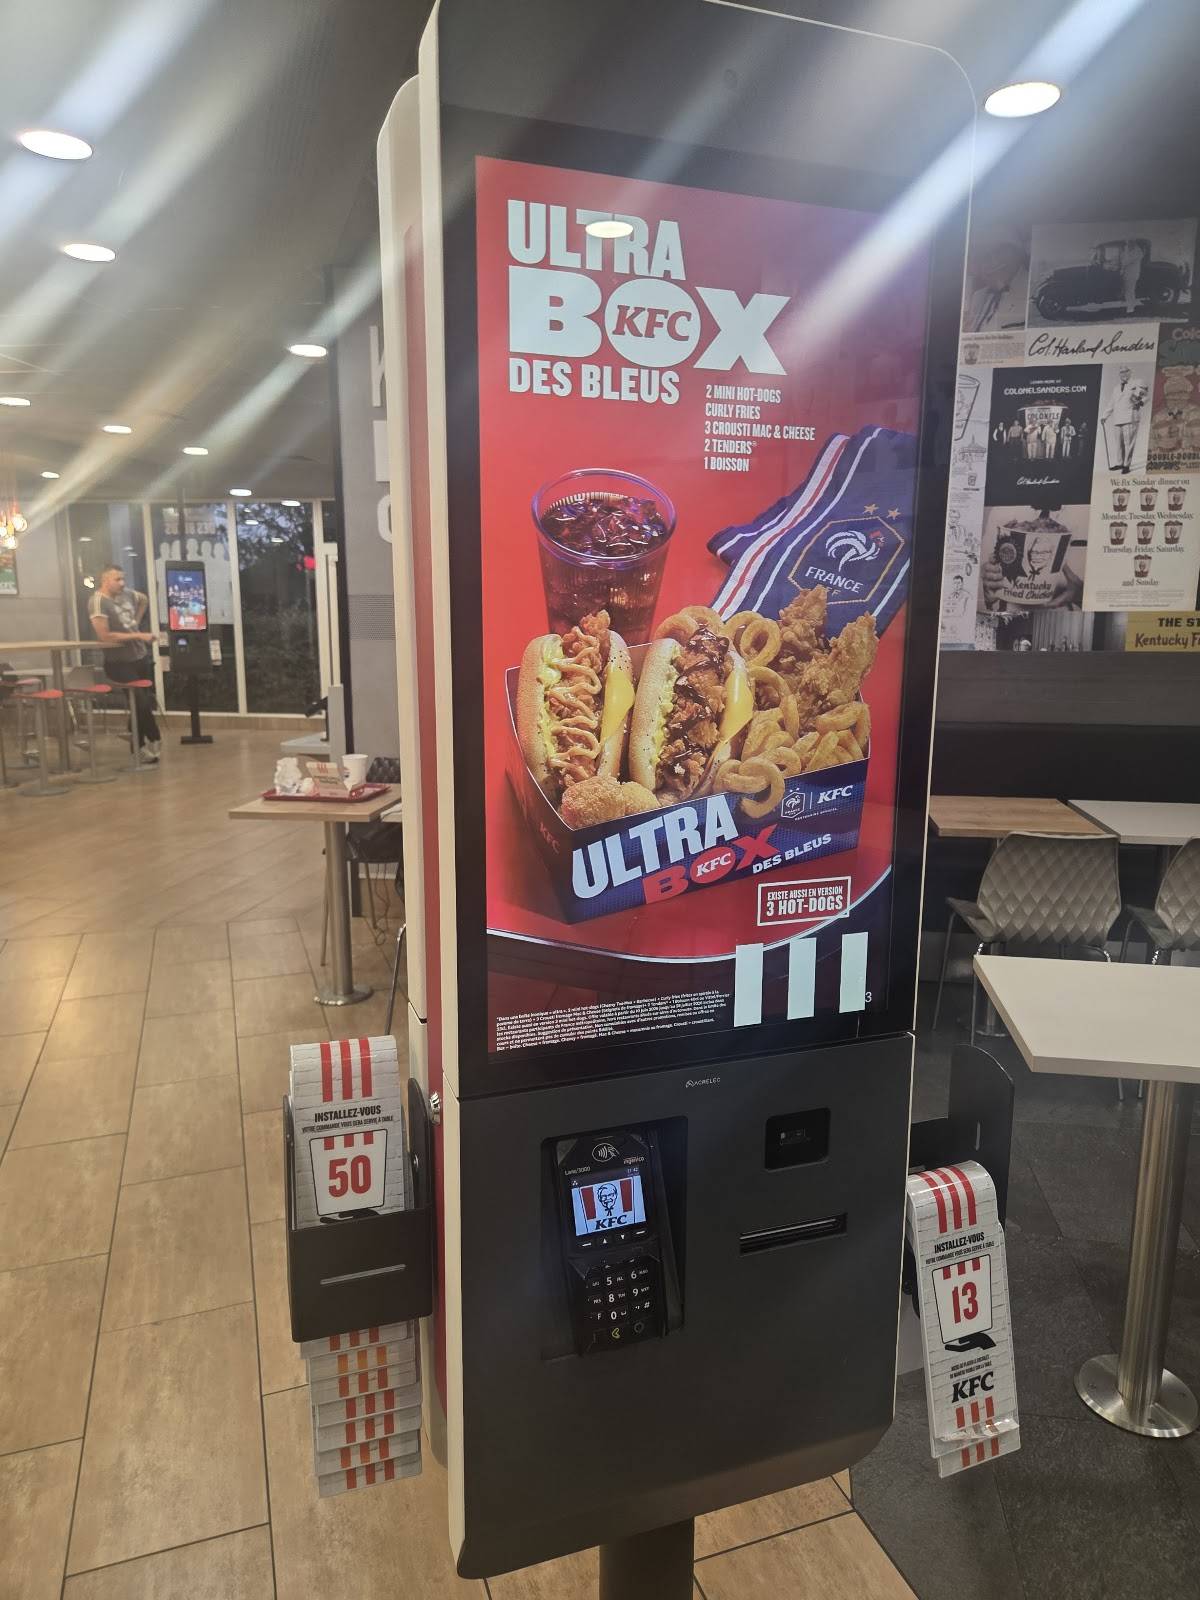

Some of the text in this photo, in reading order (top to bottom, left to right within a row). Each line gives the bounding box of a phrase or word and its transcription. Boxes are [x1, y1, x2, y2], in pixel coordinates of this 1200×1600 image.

[508, 199, 686, 281] ULTRA
[612, 304, 692, 341] KFC
[509, 357, 680, 405] DES BLEUS
[706, 384, 781, 403] 2 MINI HOT-DOGS
[705, 403, 761, 420] CURLY FRIES
[705, 421, 816, 440] 3 CROUSTI MAC & CHEESE
[704, 439, 711, 452] 2
[704, 457, 750, 472] 1 BOISSON
[1110, 478, 1120, 487] We
[1132, 478, 1157, 487] Sunday
[1157, 477, 1180, 486] dinner
[805, 566, 864, 594] FRANCE
[1122, 579, 1134, 587] and
[1158, 617, 1182, 627] THE
[1135, 632, 1189, 649] Kentucky
[817, 784, 854, 804] KFC
[571, 794, 738, 899] ULTRA
[752, 833, 832, 875] DES BLEUS
[696, 852, 732, 877] KFC
[767, 885, 843, 900] EXISTE AUSSI EN VERSION
[766, 894, 843, 916] 3 HOT-DOGS
[865, 991, 872, 1003] 3
[314, 1105, 382, 1123] INSTALLEZ-VOUS
[328, 1154, 372, 1198] 50
[595, 1214, 627, 1230] KFC
[934, 1231, 985, 1254] INSTALLEZ-VOUS
[606, 1276, 612, 1286] 5
[631, 1270, 637, 1279] 6
[608, 1293, 615, 1303] 8
[632, 1288, 639, 1297] 9
[952, 1281, 978, 1324] 13
[611, 1311, 617, 1320] 0
[952, 1371, 994, 1403] KFC
